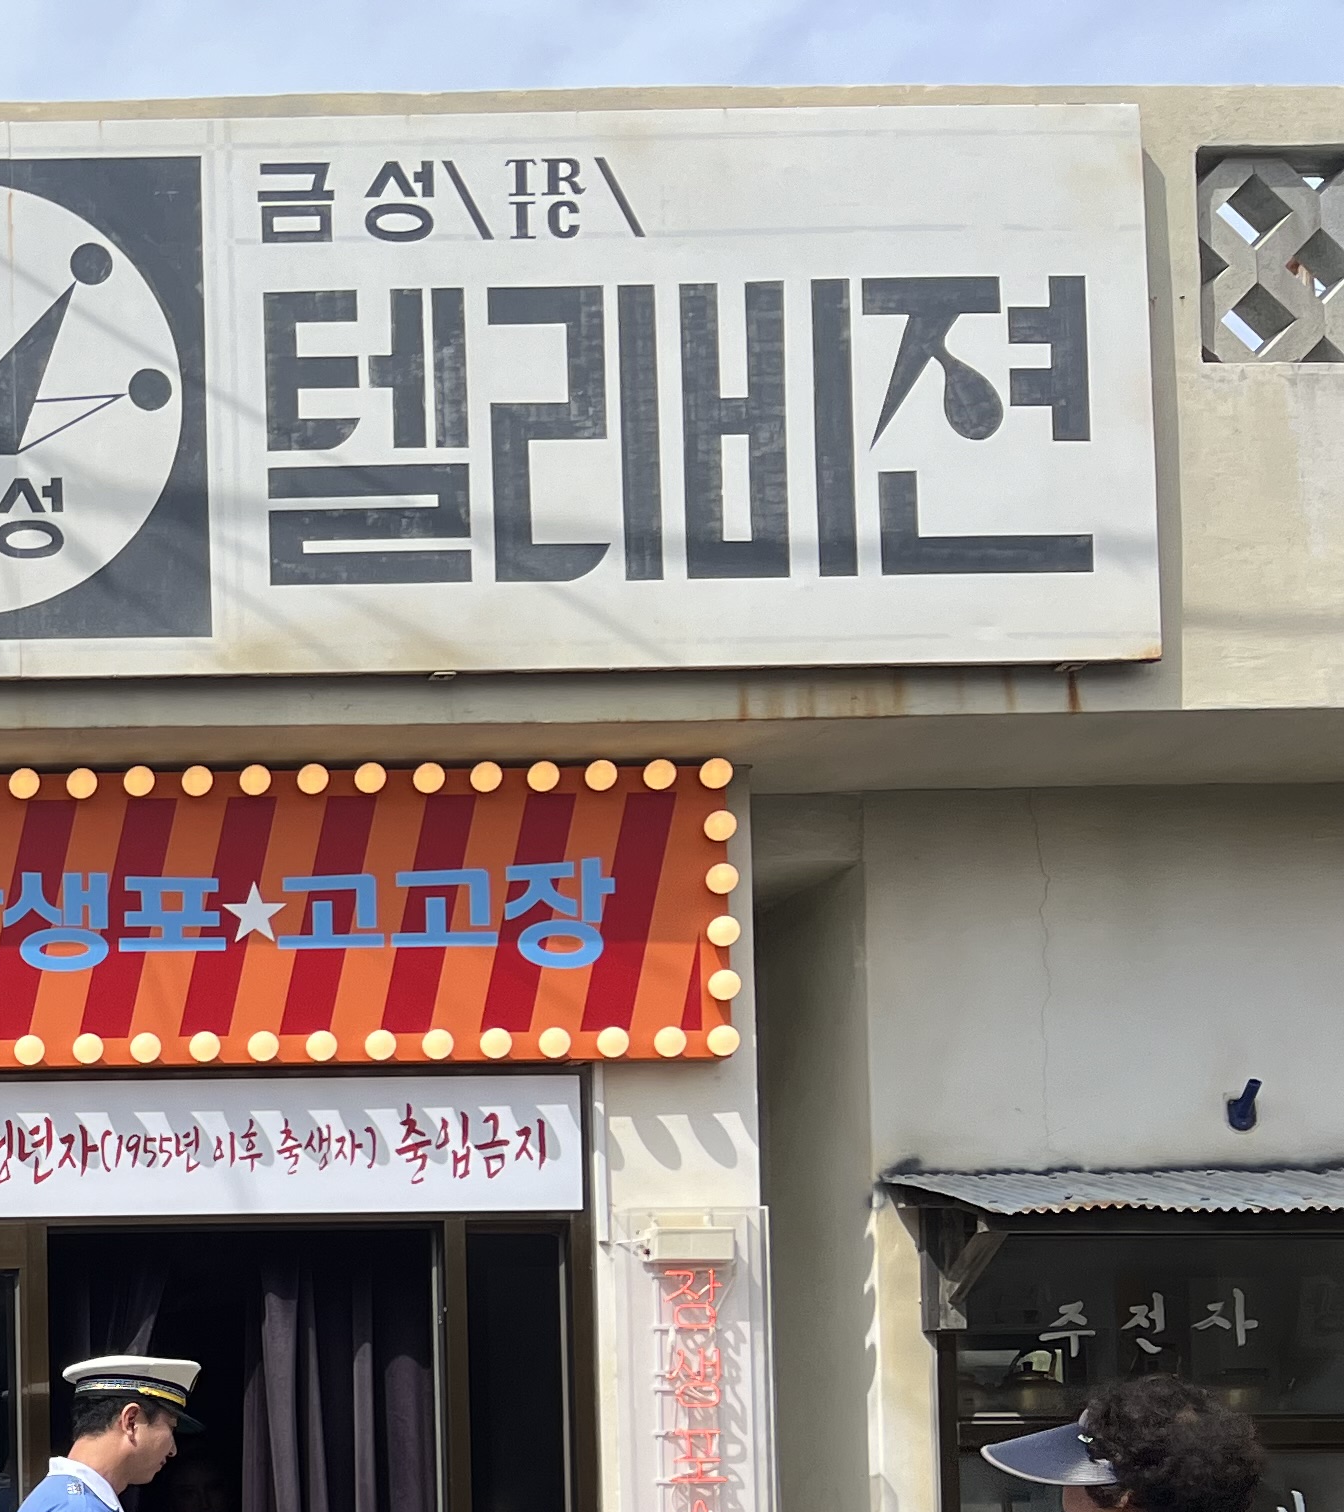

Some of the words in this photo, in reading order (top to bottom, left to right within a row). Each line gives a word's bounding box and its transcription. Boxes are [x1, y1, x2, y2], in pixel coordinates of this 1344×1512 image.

[257, 160, 435, 243] 금성
[262, 275, 1094, 587] 텔리비젼
[277, 856, 616, 969] 고고장
[212, 1118, 264, 1173] 이후
[394, 1103, 547, 1186] 출입금지
[1038, 1287, 1260, 1357] 주전자
